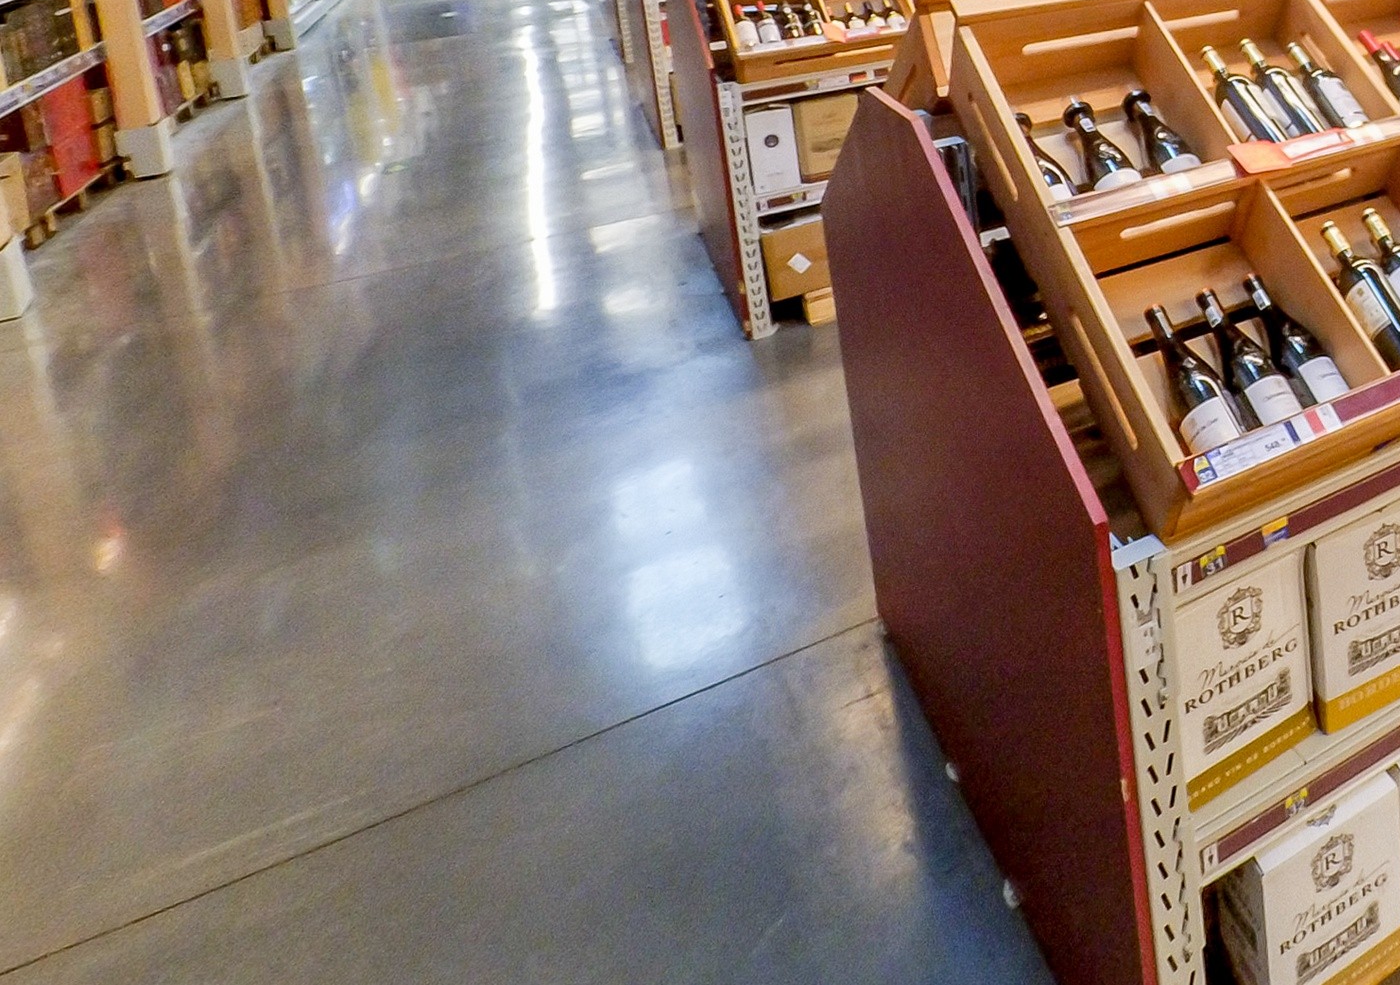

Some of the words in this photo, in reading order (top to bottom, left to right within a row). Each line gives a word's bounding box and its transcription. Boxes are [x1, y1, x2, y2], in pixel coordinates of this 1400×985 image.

[1374, 541, 1394, 561] R
[1230, 605, 1251, 629] R
[1183, 637, 1299, 714] ROTHBERG
[1325, 852, 1343, 871] R
[1278, 872, 1389, 957] ROTHBERG
